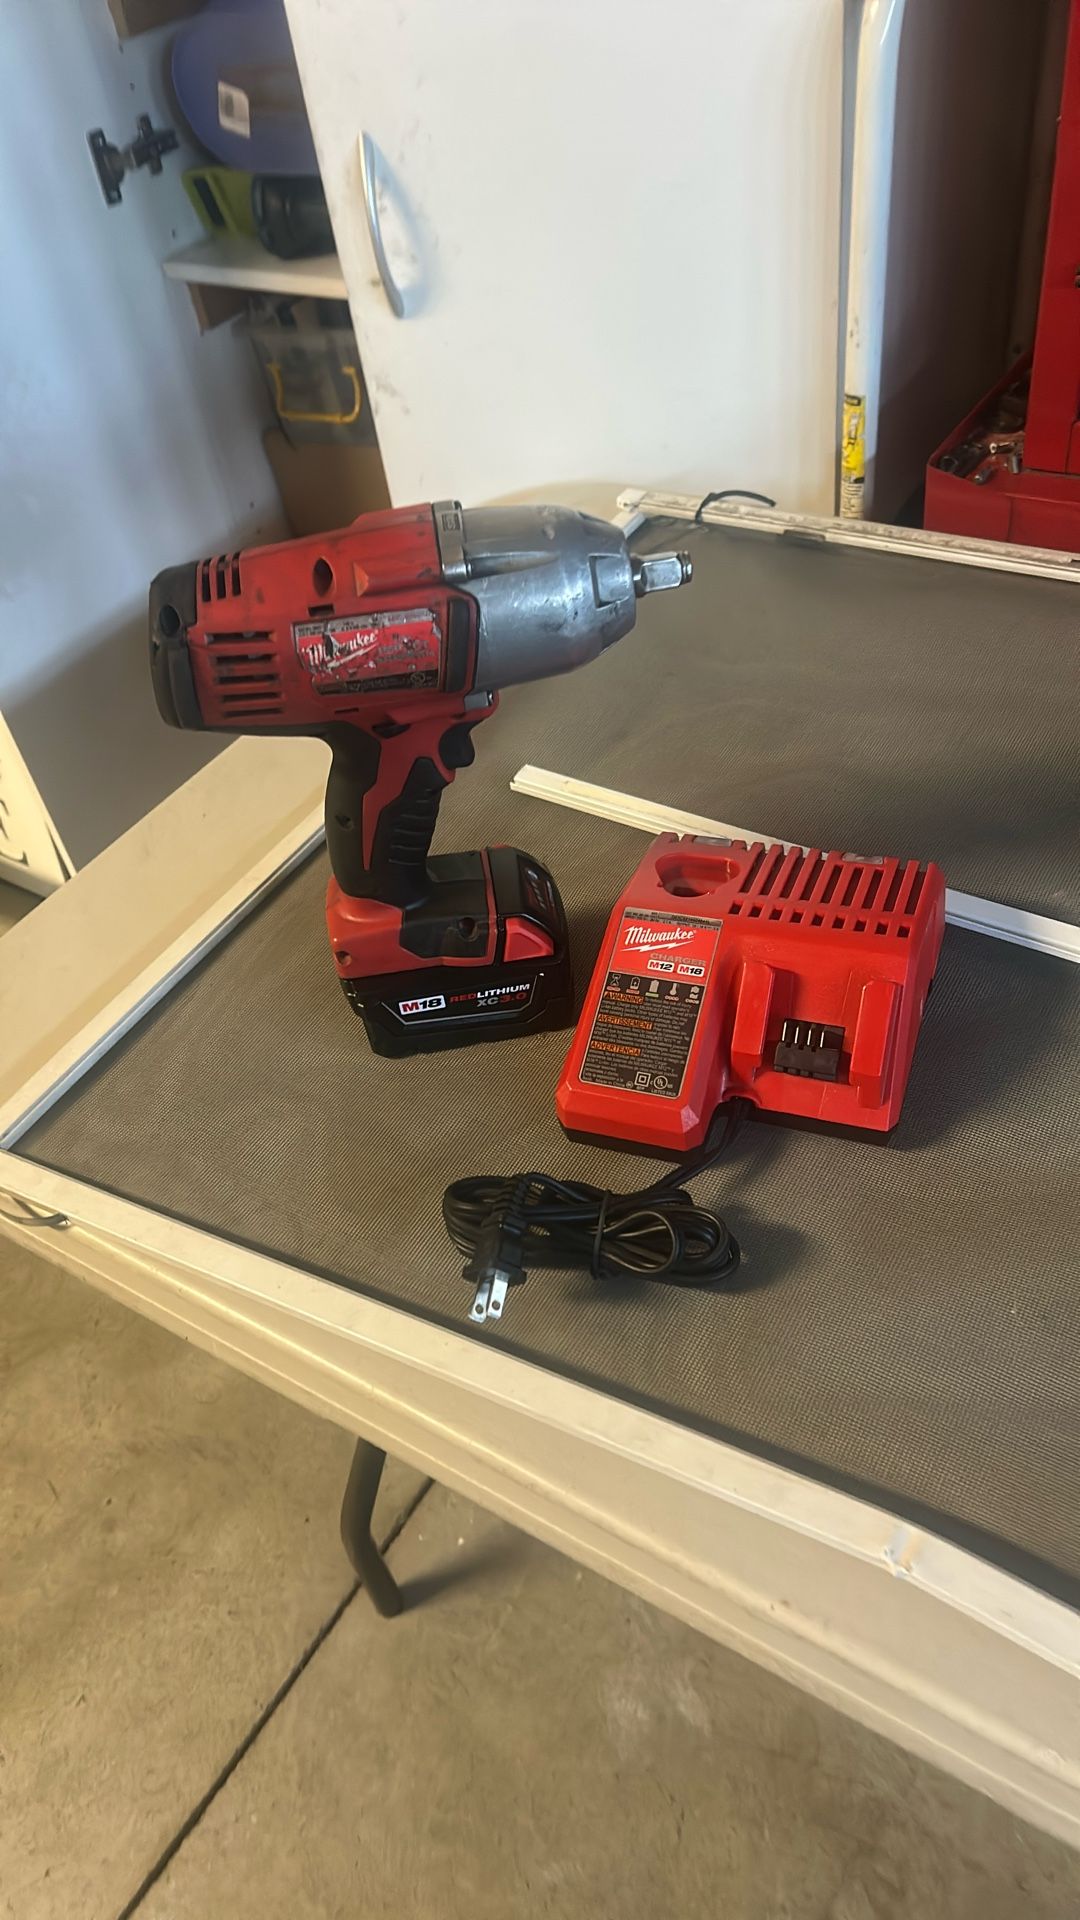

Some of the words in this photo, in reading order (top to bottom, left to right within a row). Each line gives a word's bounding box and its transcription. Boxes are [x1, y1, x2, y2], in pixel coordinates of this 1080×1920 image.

[624, 926, 695, 946] Milwaukee
[651, 953, 706, 966] CHARGER
[649, 961, 673, 971] M12
[679, 965, 704, 975] M18
[401, 999, 442, 1012] M18
[450, 983, 530, 1003] REDLITHIUM
[612, 992, 644, 1005] WARNING
[591, 1041, 640, 1056] ADVERTENCIA
